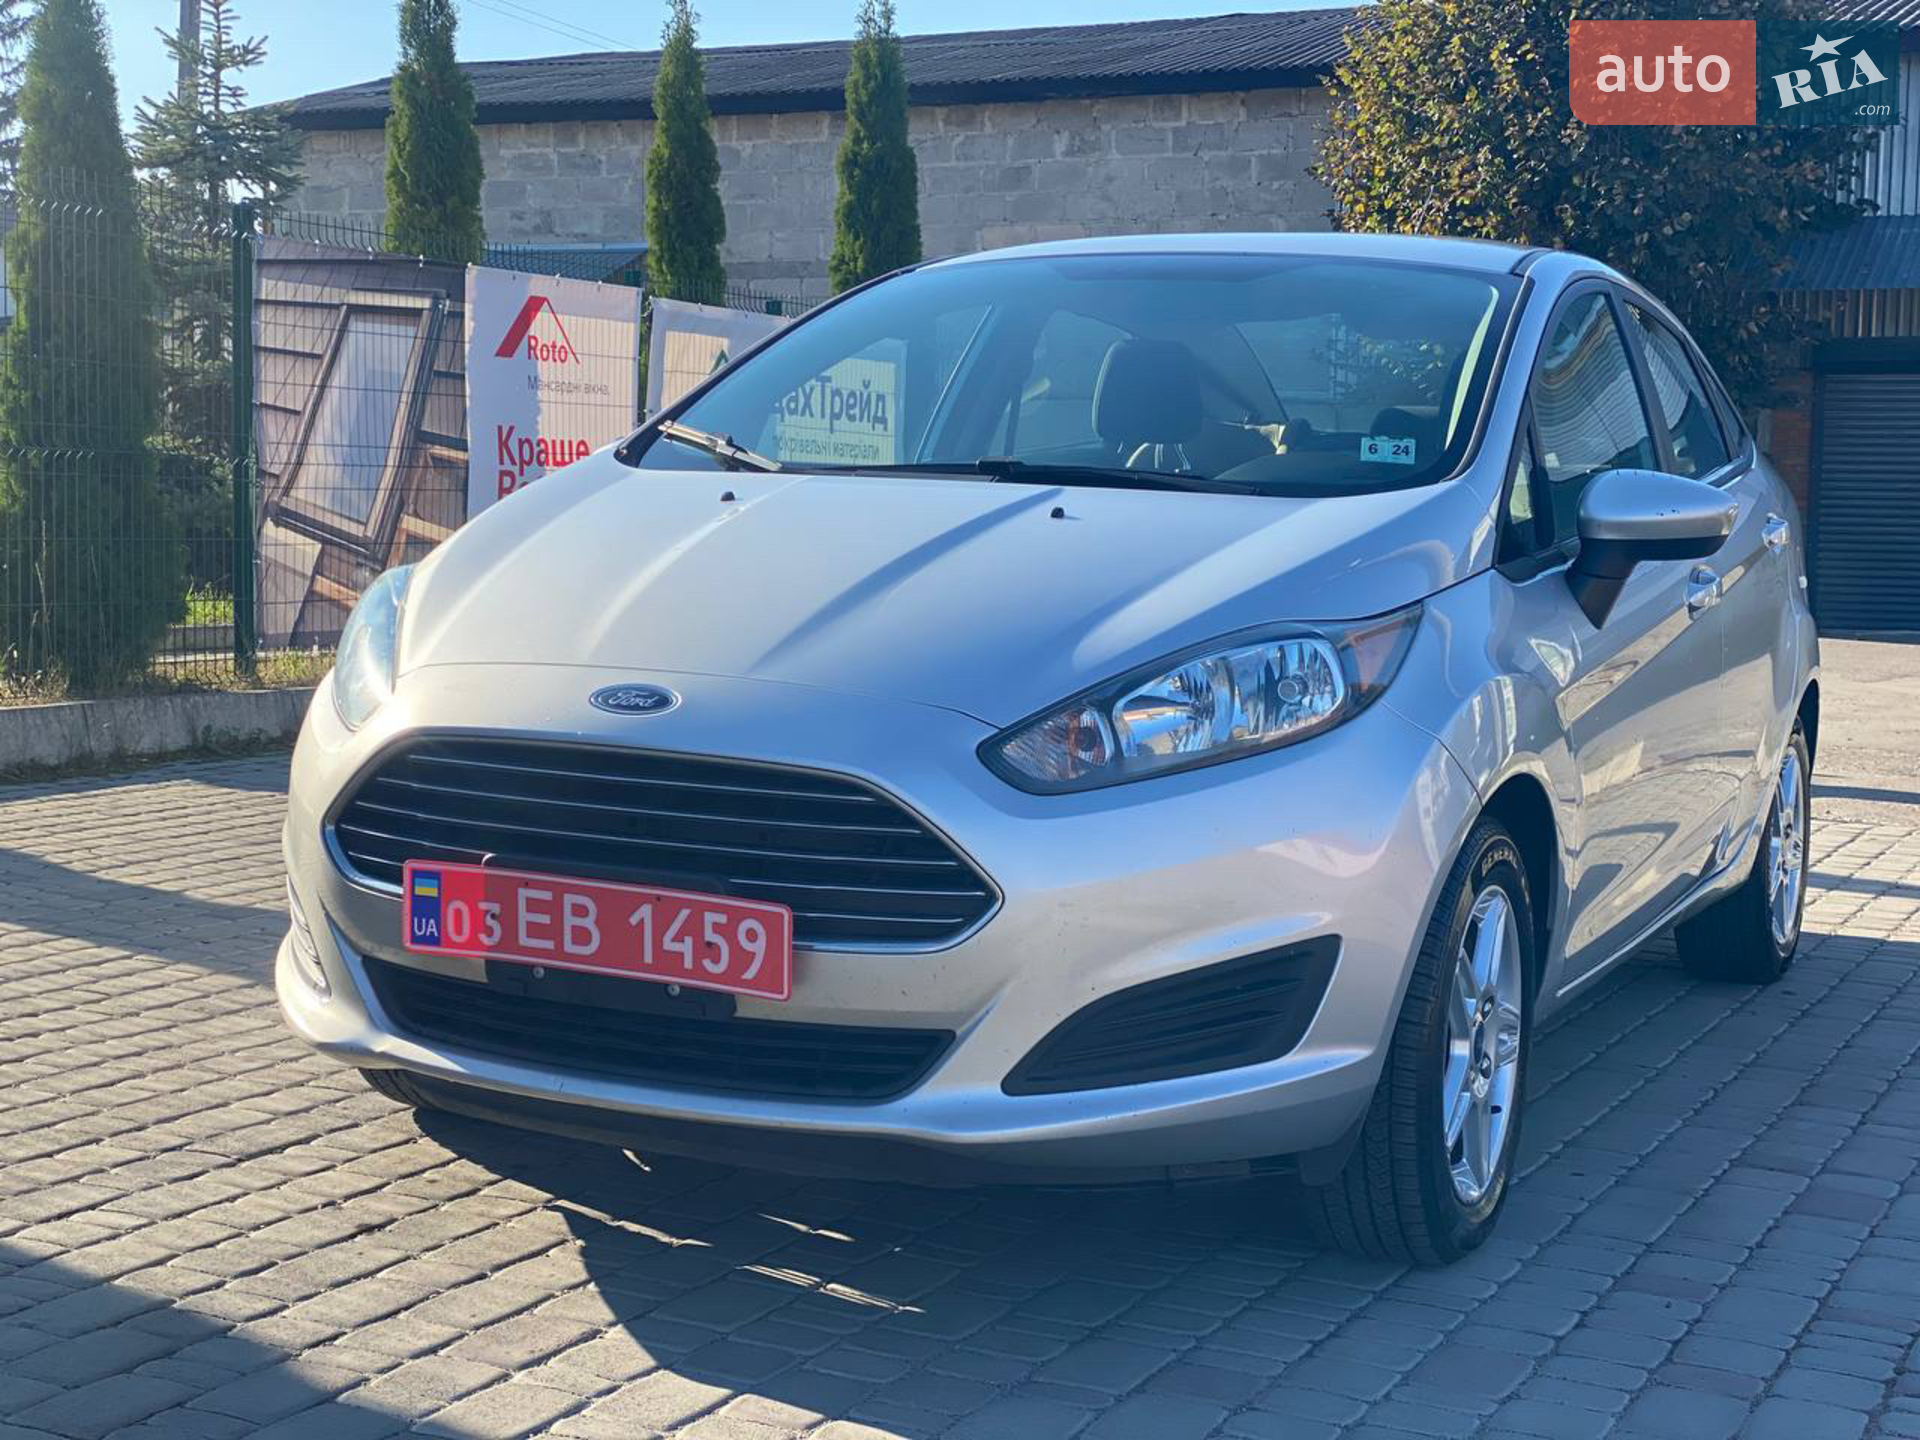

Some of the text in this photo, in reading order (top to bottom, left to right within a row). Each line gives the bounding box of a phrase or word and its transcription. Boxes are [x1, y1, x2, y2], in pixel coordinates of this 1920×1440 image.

[527, 335, 568, 364] Roto
[497, 424, 591, 477] Краше
[1367, 443, 1410, 456] 6 24
[608, 689, 659, 707] Ford
[414, 917, 438, 937] UA
[446, 900, 502, 945] 03
[628, 902, 767, 981] 1459
